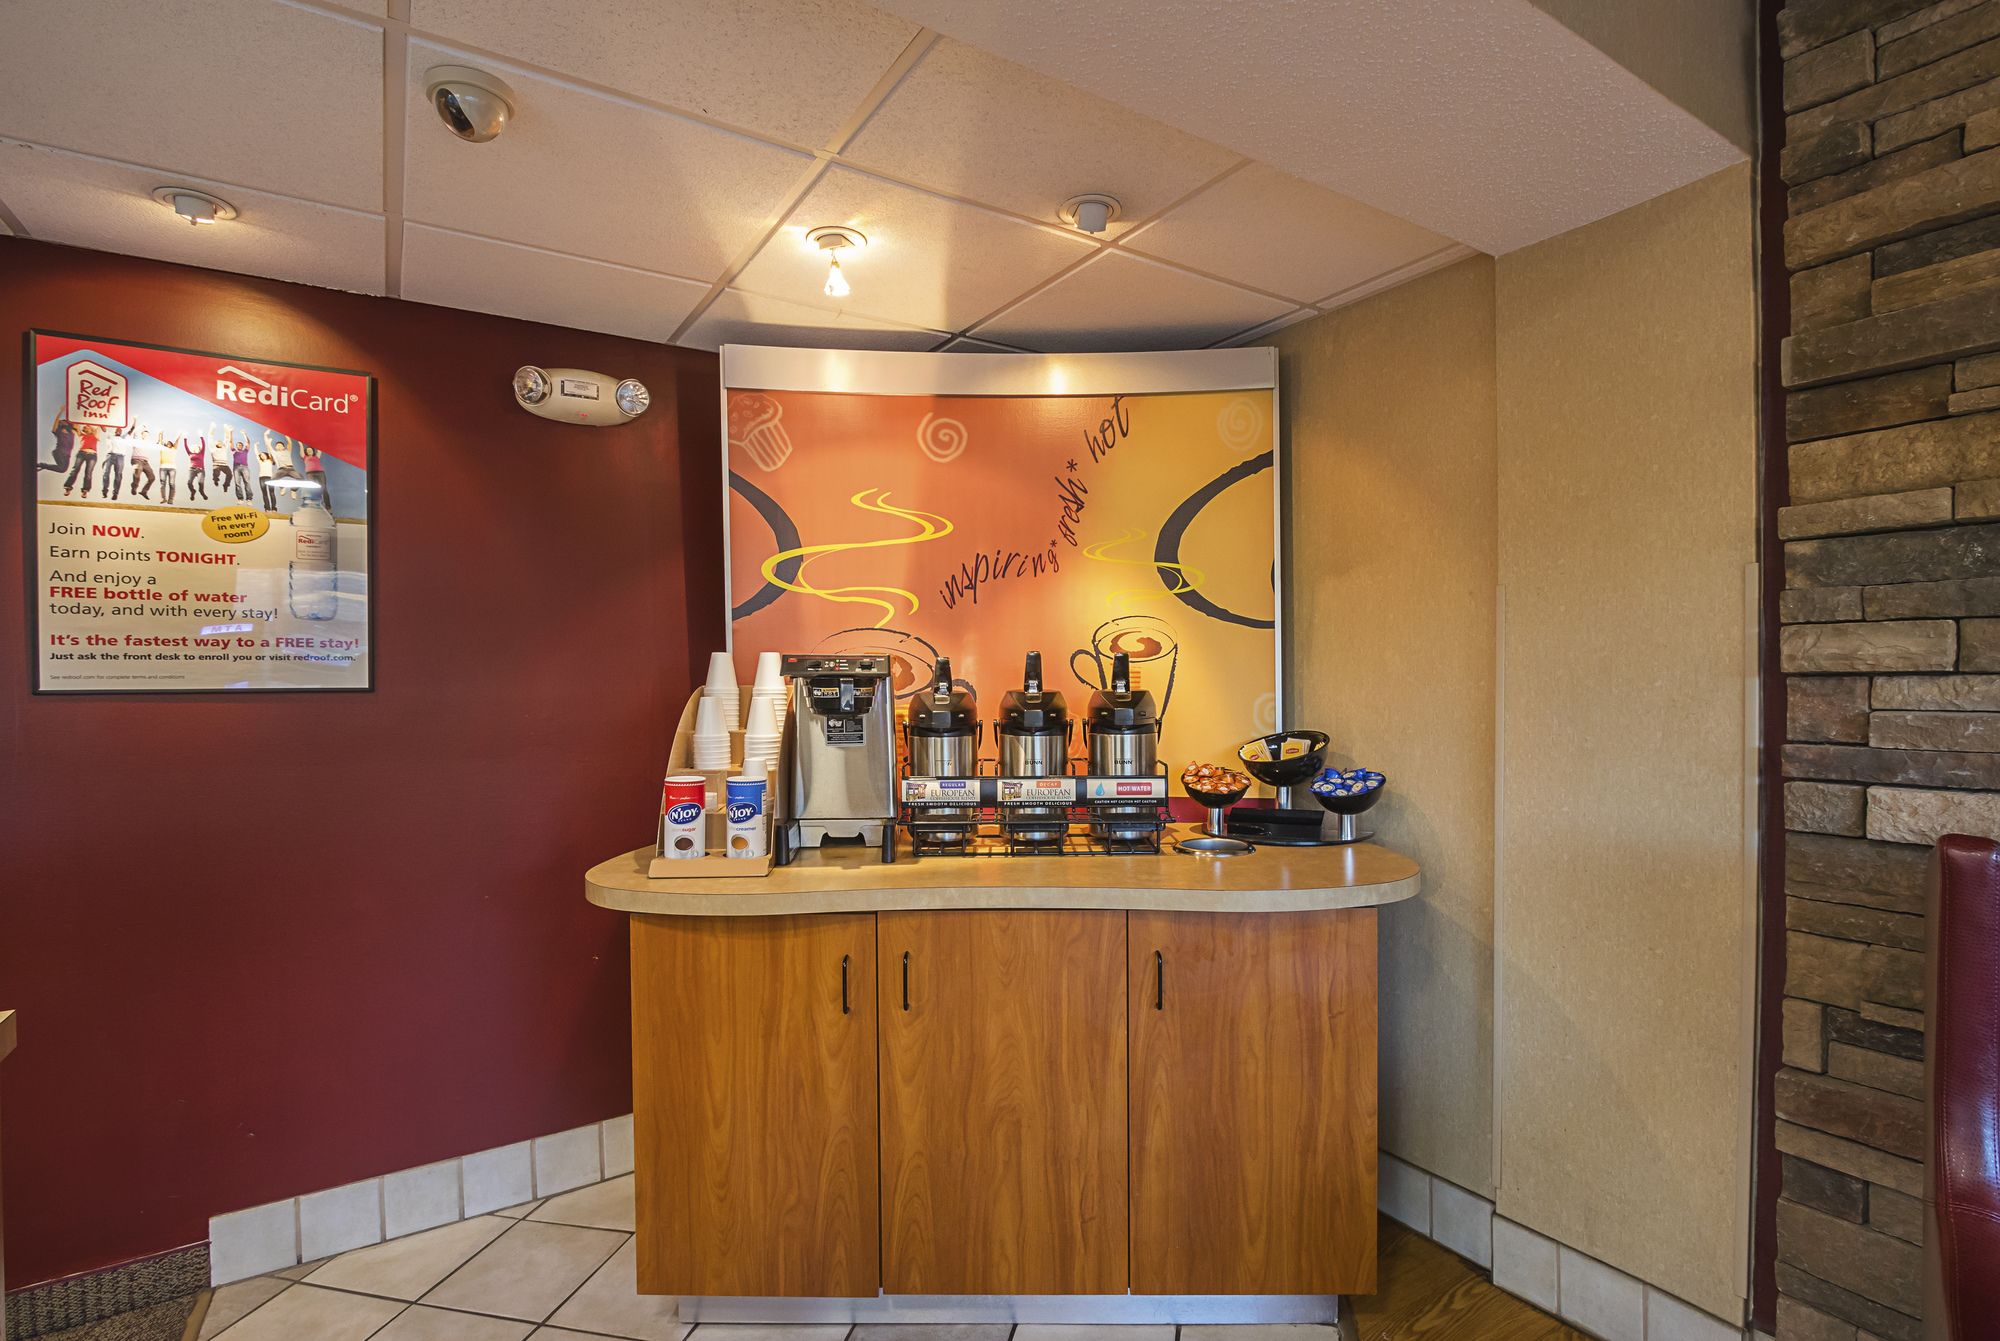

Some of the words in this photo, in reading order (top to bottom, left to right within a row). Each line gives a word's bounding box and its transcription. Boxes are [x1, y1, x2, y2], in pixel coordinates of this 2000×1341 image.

[80, 379, 111, 397] Red
[77, 394, 119, 413] Roof
[1084, 396, 1129, 463] hot
[211, 515, 232, 523] Free
[234, 511, 258, 521] Wi-Fi
[49, 522, 86, 535] Join
[92, 525, 145, 538] NOW.
[217, 523, 227, 531] in
[229, 522, 255, 530] every
[223, 530, 254, 538] room!
[50, 546, 90, 558] Earn
[97, 549, 151, 562] points
[156, 550, 241, 566] TONIGHT.
[49, 570, 87, 583] And
[93, 572, 141, 587] enjoy
[147, 575, 157, 585] a
[50, 586, 97, 599] FREE
[104, 587, 163, 601] bottle
[168, 590, 189, 602] of
[194, 592, 248, 603] water
[50, 602, 105, 617] today,
[111, 604, 144, 615] and
[149, 605, 188, 617] with
[193, 608, 237, 621] every
[241, 607, 278, 622] stay!
[50, 634, 80, 646] It’s
[86, 634, 119, 646] the
[124, 634, 189, 647] fastest
[193, 637, 231, 649] way
[236, 636, 255, 648] to
[260, 639, 270, 648] a
[275, 637, 315, 648] FREE
[319, 638, 359, 650] stay!
[50, 652, 75, 661] Just
[77, 652, 97, 661] ask
[100, 652, 120, 661] the
[123, 652, 152, 661] front
[155, 653, 181, 661] desk
[184, 653, 196, 661] to
[198, 653, 230, 661] enroll
[232, 654, 252, 662] you
[269, 653, 291, 661] visit
[293, 653, 356, 661] redroof.com.
[930, 789, 976, 797] EUROPEAN
